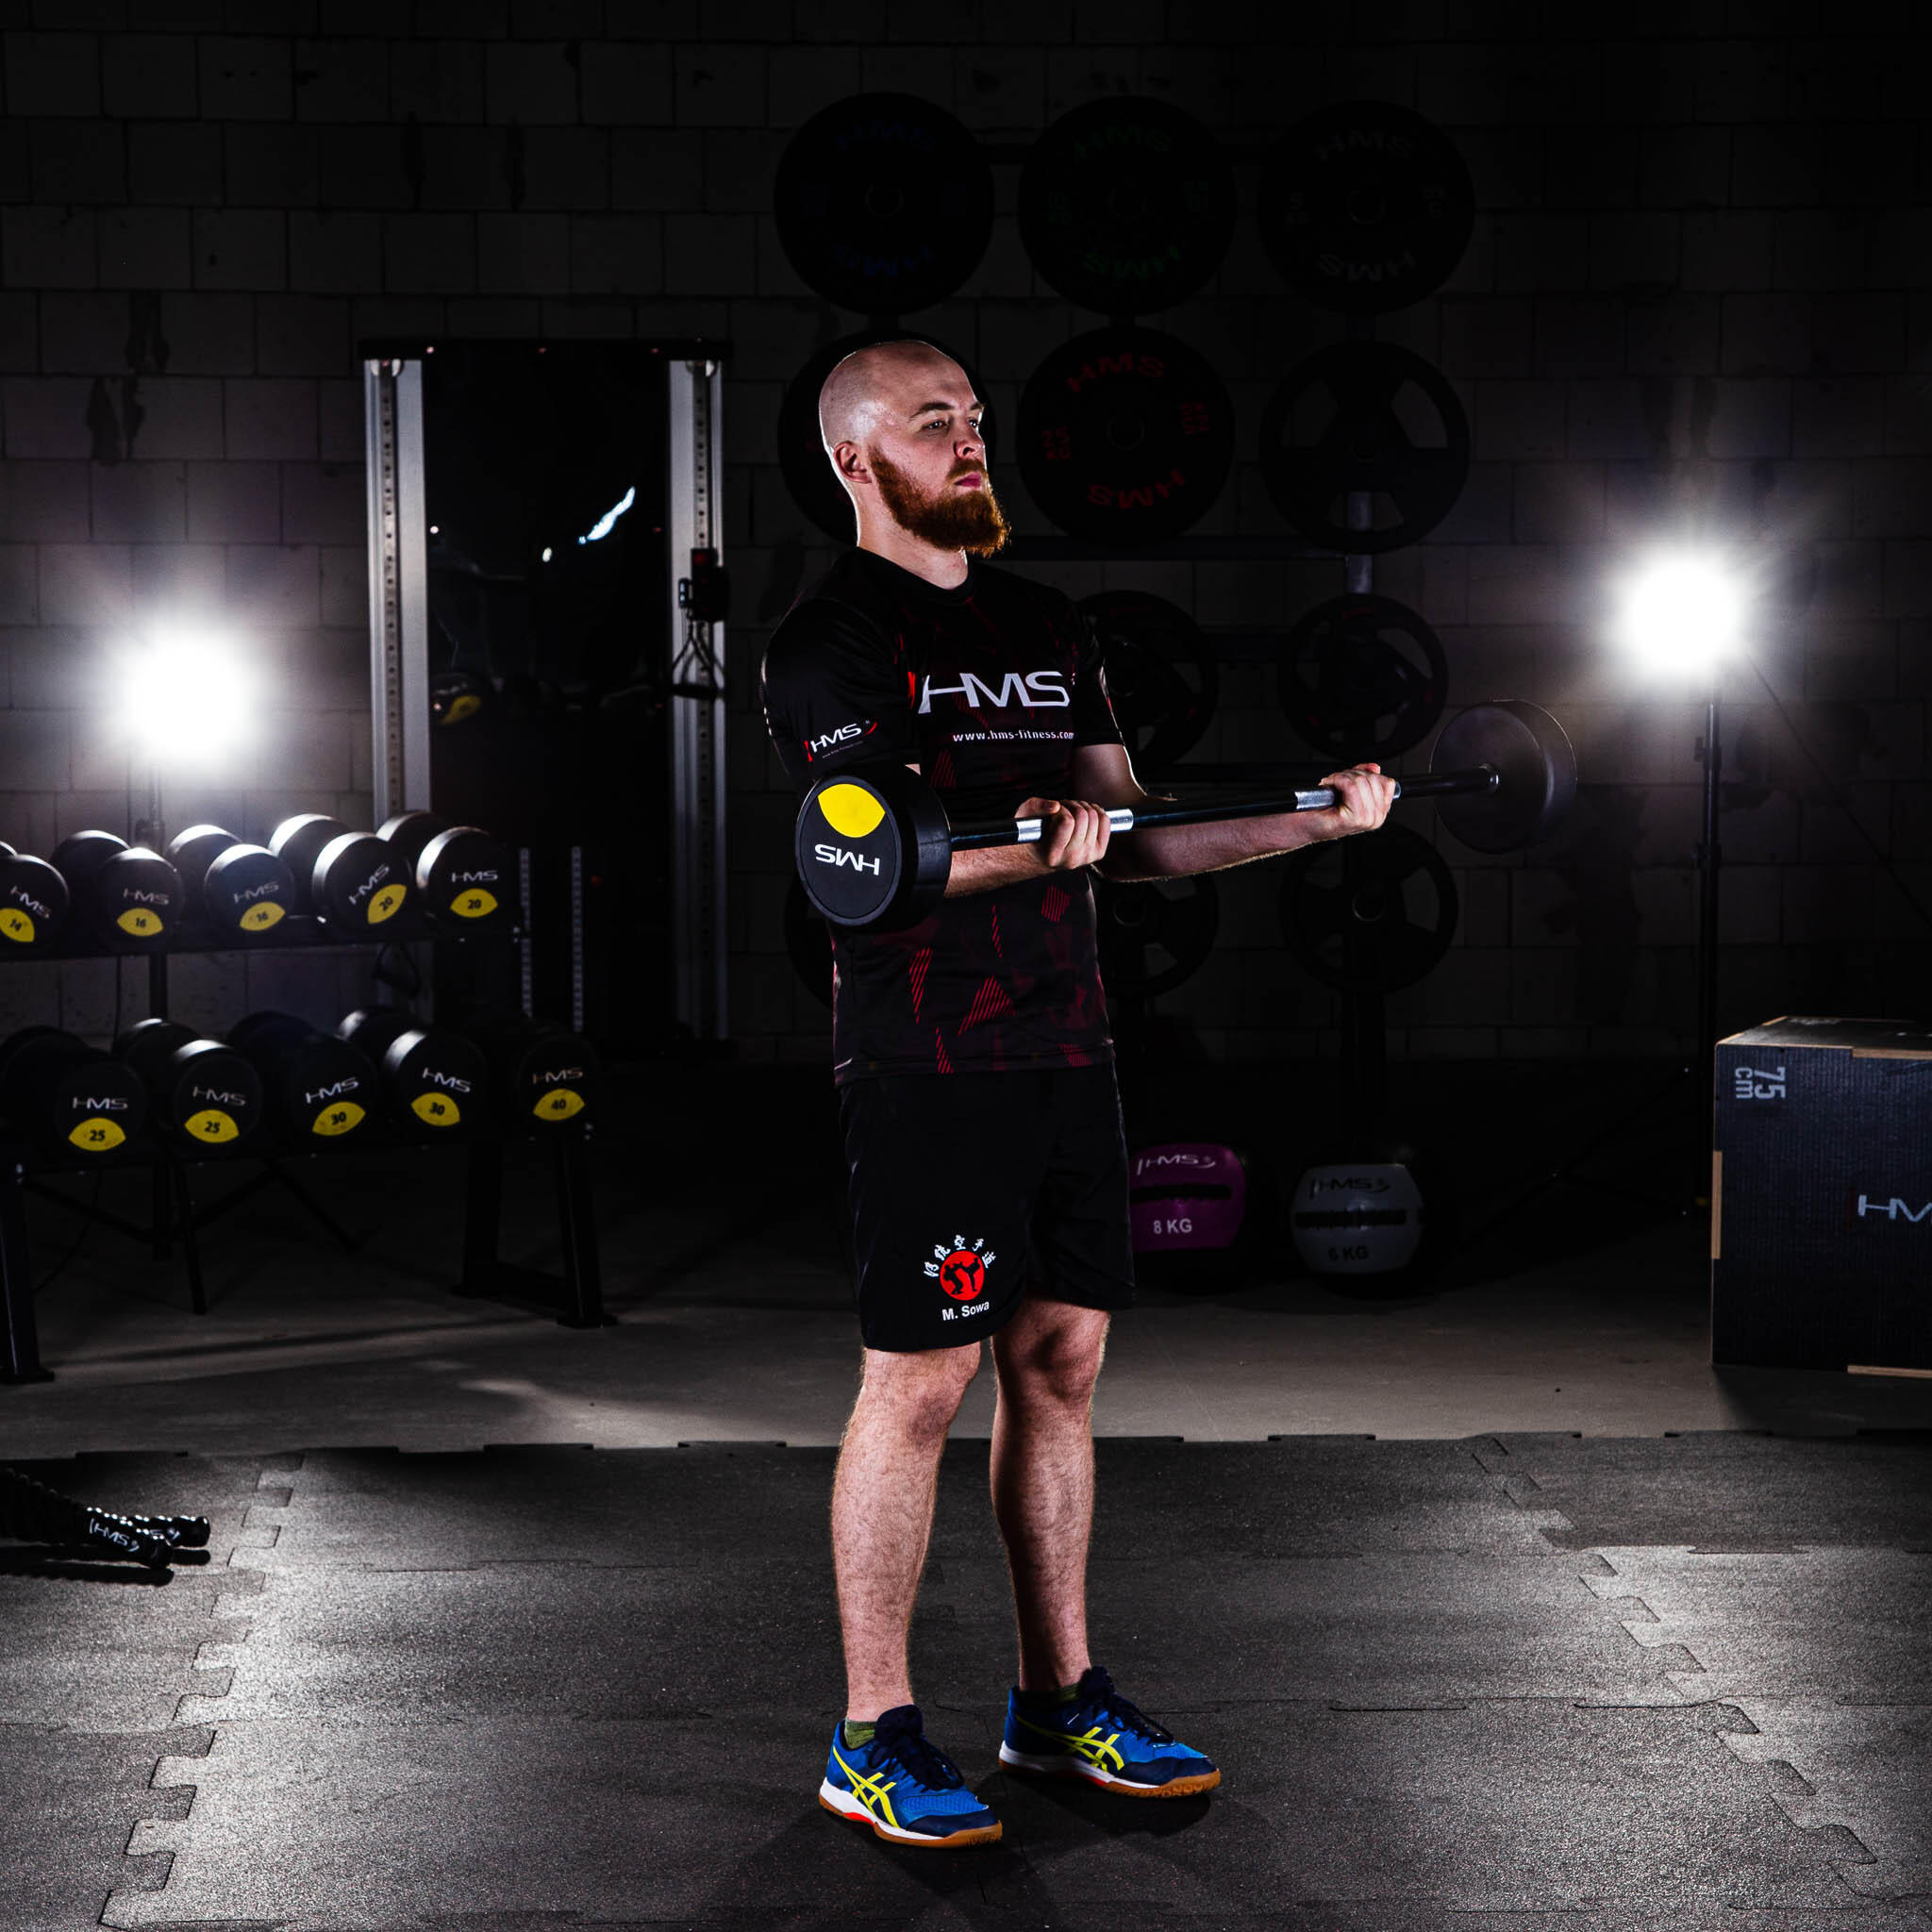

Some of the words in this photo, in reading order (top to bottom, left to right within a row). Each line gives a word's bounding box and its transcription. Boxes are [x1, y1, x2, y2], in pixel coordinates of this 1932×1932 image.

[1066, 352, 1166, 393] HMS
[1087, 469, 1185, 509] HMS
[917, 671, 1071, 714] HMS
[810, 723, 861, 753] HMS
[815, 843, 880, 875] HMS
[348, 862, 391, 906] HMS
[451, 870, 498, 883] HMS
[9, 885, 52, 919] HMS
[123, 888, 170, 906] HMS
[233, 881, 280, 904] HMS
[379, 897, 393, 911] 20
[467, 898, 482, 909] 20
[422, 1067, 472, 1093] HMS
[532, 1067, 584, 1084] HMS
[1735, 1066, 1754, 1100] cm
[1754, 1066, 1786, 1100] 75
[192, 1085, 246, 1108] HMS
[305, 1076, 359, 1104] HMS
[72, 1096, 128, 1110] HMS
[429, 1102, 444, 1115] 30
[551, 1098, 567, 1111] 40
[205, 1121, 220, 1134] 25
[331, 1111, 346, 1124] 30
[90, 1129, 105, 1141] 25
[1154, 1220, 1162, 1235] 8
[1167, 1218, 1192, 1234] KG
[1343, 1245, 1368, 1260] KG
[942, 1307, 958, 1321] M.
[962, 1301, 990, 1317] Sowa
[93, 1522, 130, 1547] HMS
